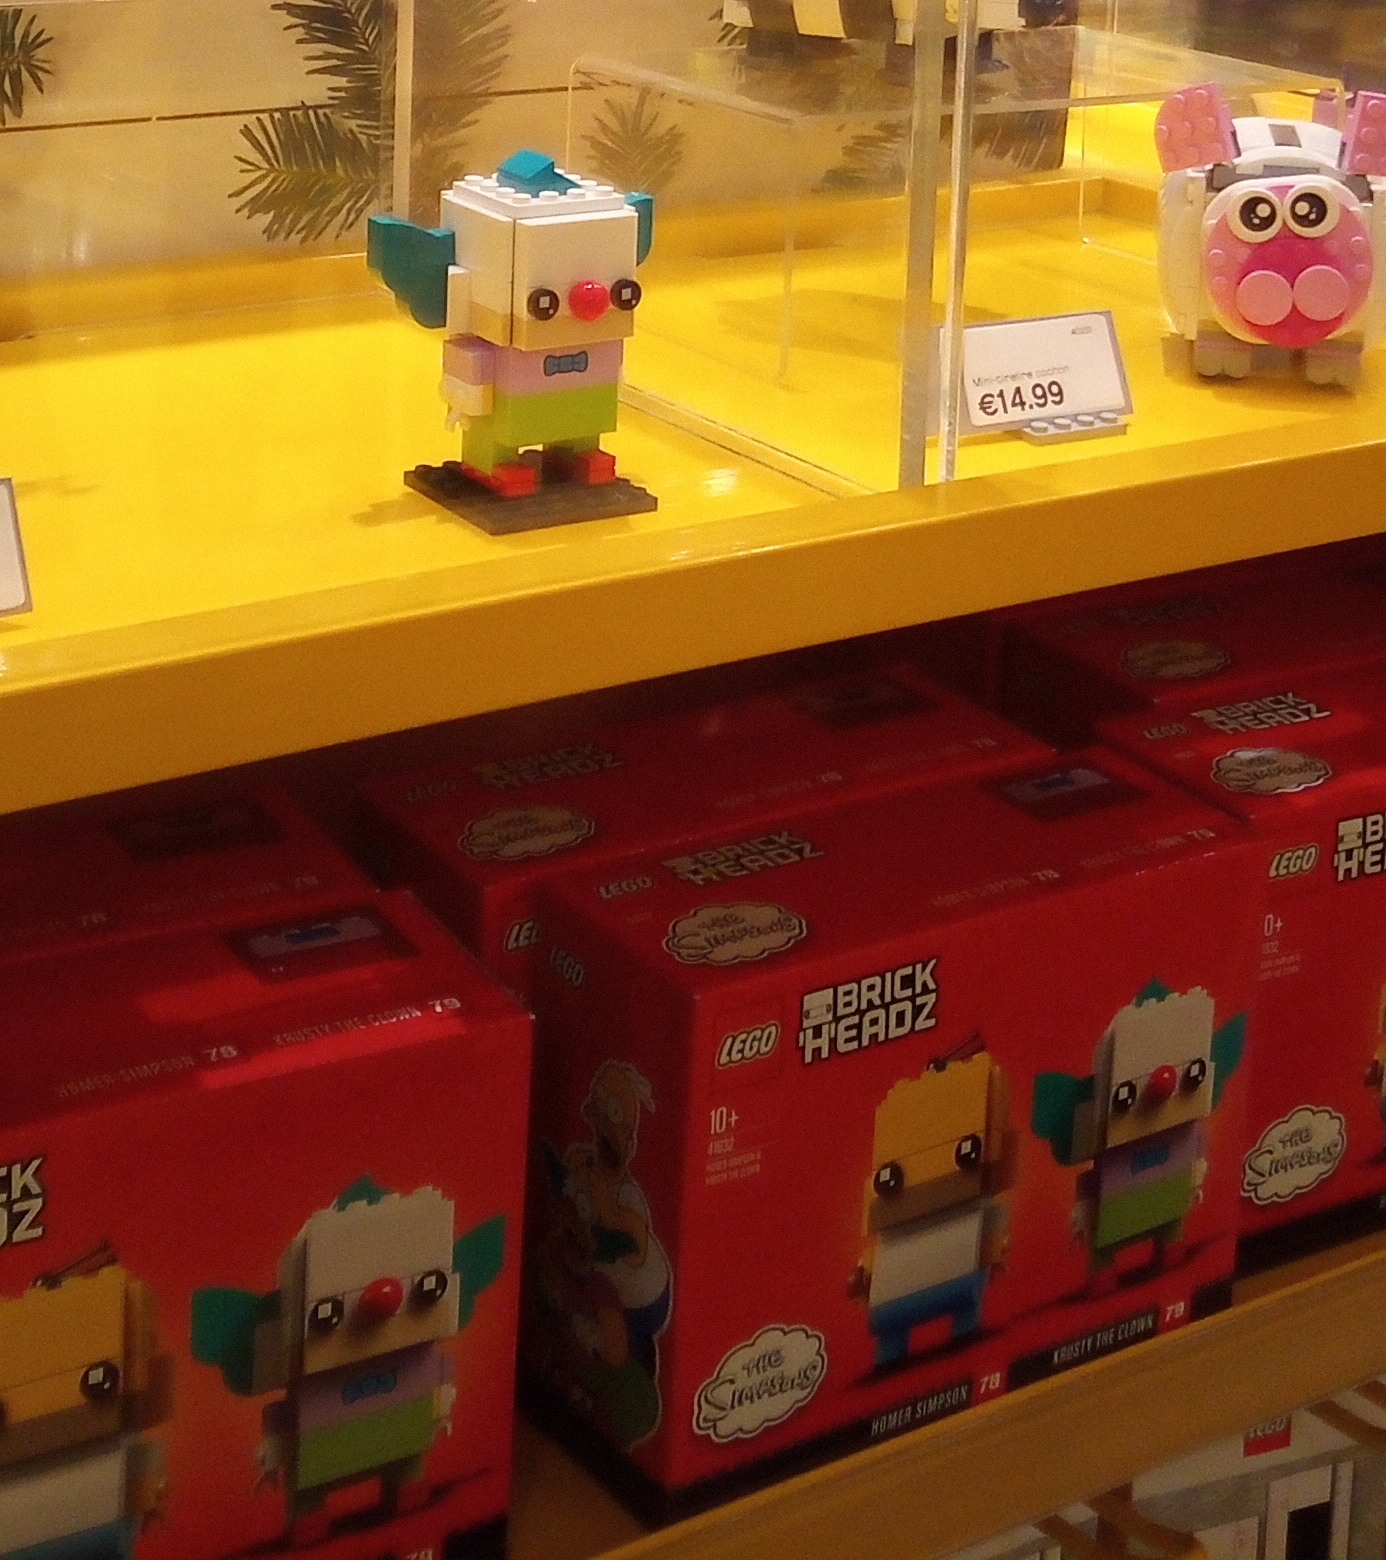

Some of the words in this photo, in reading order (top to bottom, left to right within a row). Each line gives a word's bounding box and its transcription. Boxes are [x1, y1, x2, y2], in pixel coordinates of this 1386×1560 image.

[978, 380, 1065, 417] €14.99
[1207, 702, 1331, 734] HEADZ
[1215, 692, 1307, 719] BRICK
[681, 841, 825, 886] HEADZ
[696, 830, 794, 866] BRICK
[1268, 843, 1320, 880] LEGO
[598, 876, 654, 899] LEGO
[507, 920, 540, 951] LE
[1264, 913, 1284, 937] 0+
[549, 945, 585, 987] LEGO
[835, 957, 938, 1018] BRICK
[273, 1024, 331, 1047] KRUSTY
[717, 1022, 779, 1067] LEGO
[798, 991, 938, 1065] HEADZ
[120, 1055, 195, 1083] SIMPSON
[710, 1106, 739, 1135] 10+
[1053, 1342, 1094, 1367] KRUSTY
[1095, 1331, 1117, 1354] THE
[1117, 1314, 1155, 1347] CLOWN
[740, 1347, 783, 1377] THE
[871, 1405, 914, 1438] HOMER
[915, 1384, 970, 1420] SIMPSON
